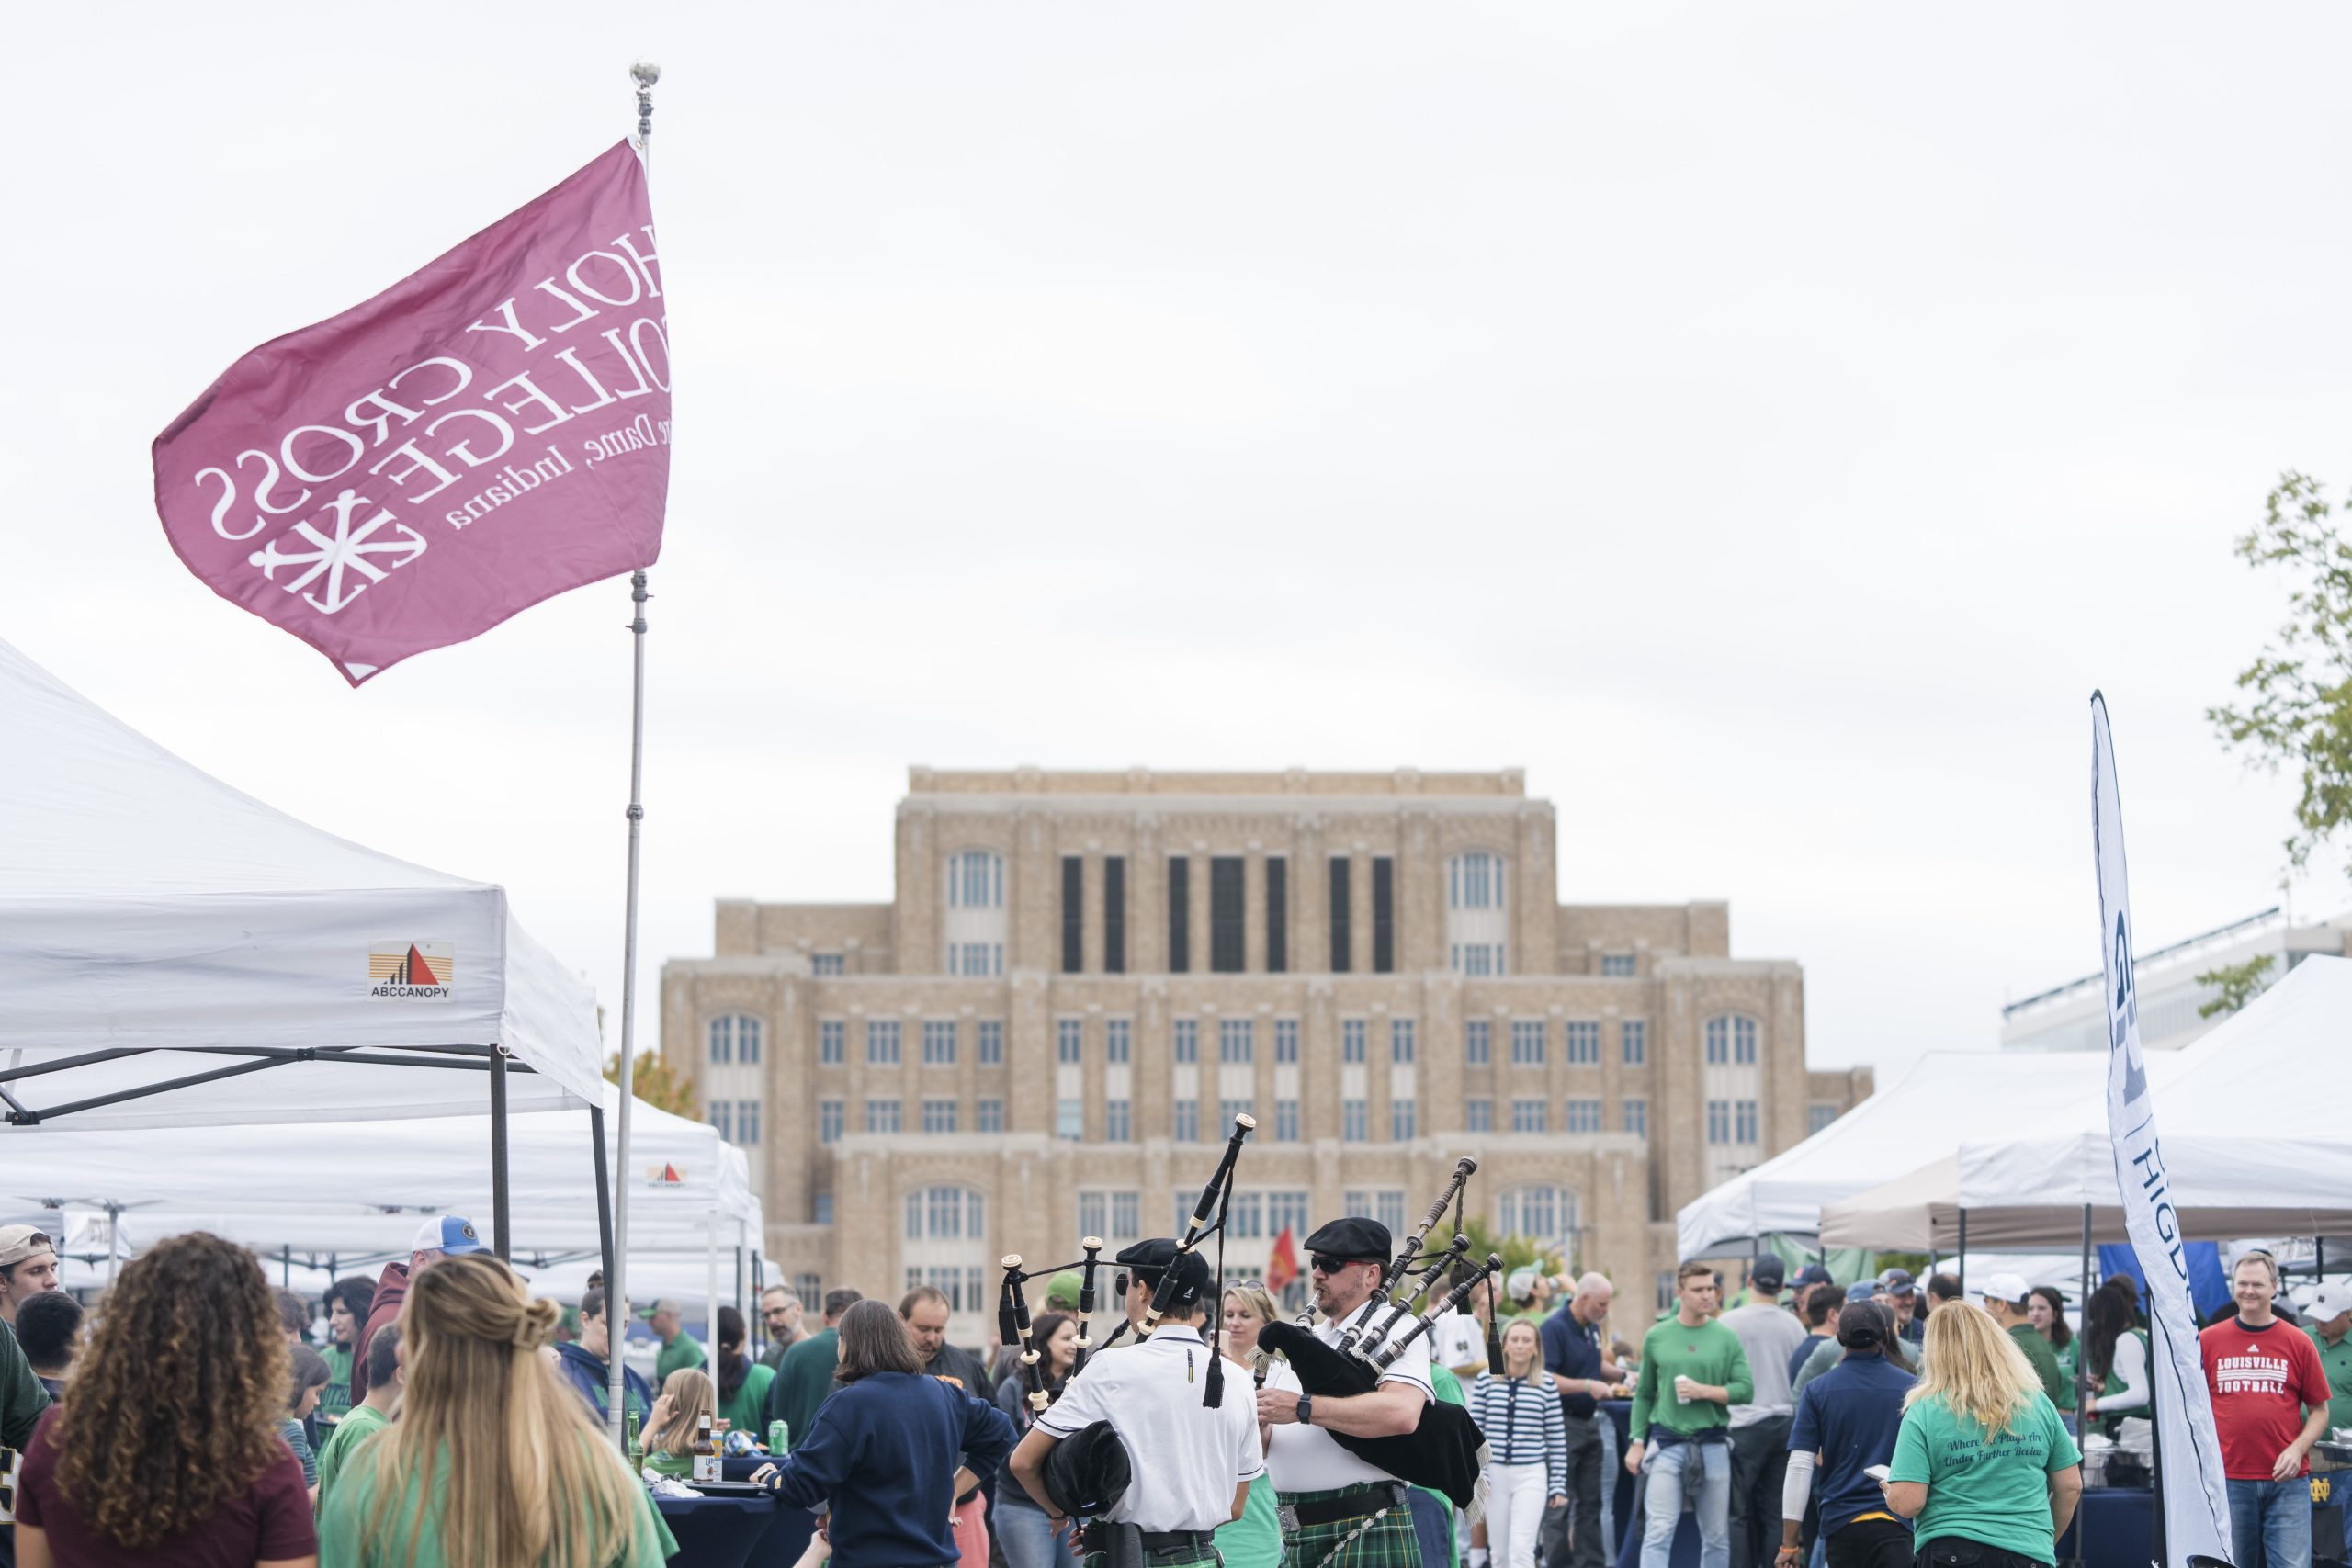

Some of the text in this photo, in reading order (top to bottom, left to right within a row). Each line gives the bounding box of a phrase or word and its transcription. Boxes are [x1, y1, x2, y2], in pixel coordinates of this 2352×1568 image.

[371, 987, 449, 998] ABCCANOPY
[2217, 1357, 2288, 1371] LOUISVILLE
[2217, 1380, 2285, 1394] FOOTBALL
[1948, 1438, 1979, 1451] Where
[1998, 1433, 2026, 1444] Plays
[1943, 1453, 1974, 1467] Under
[1976, 1448, 2012, 1461] Further
